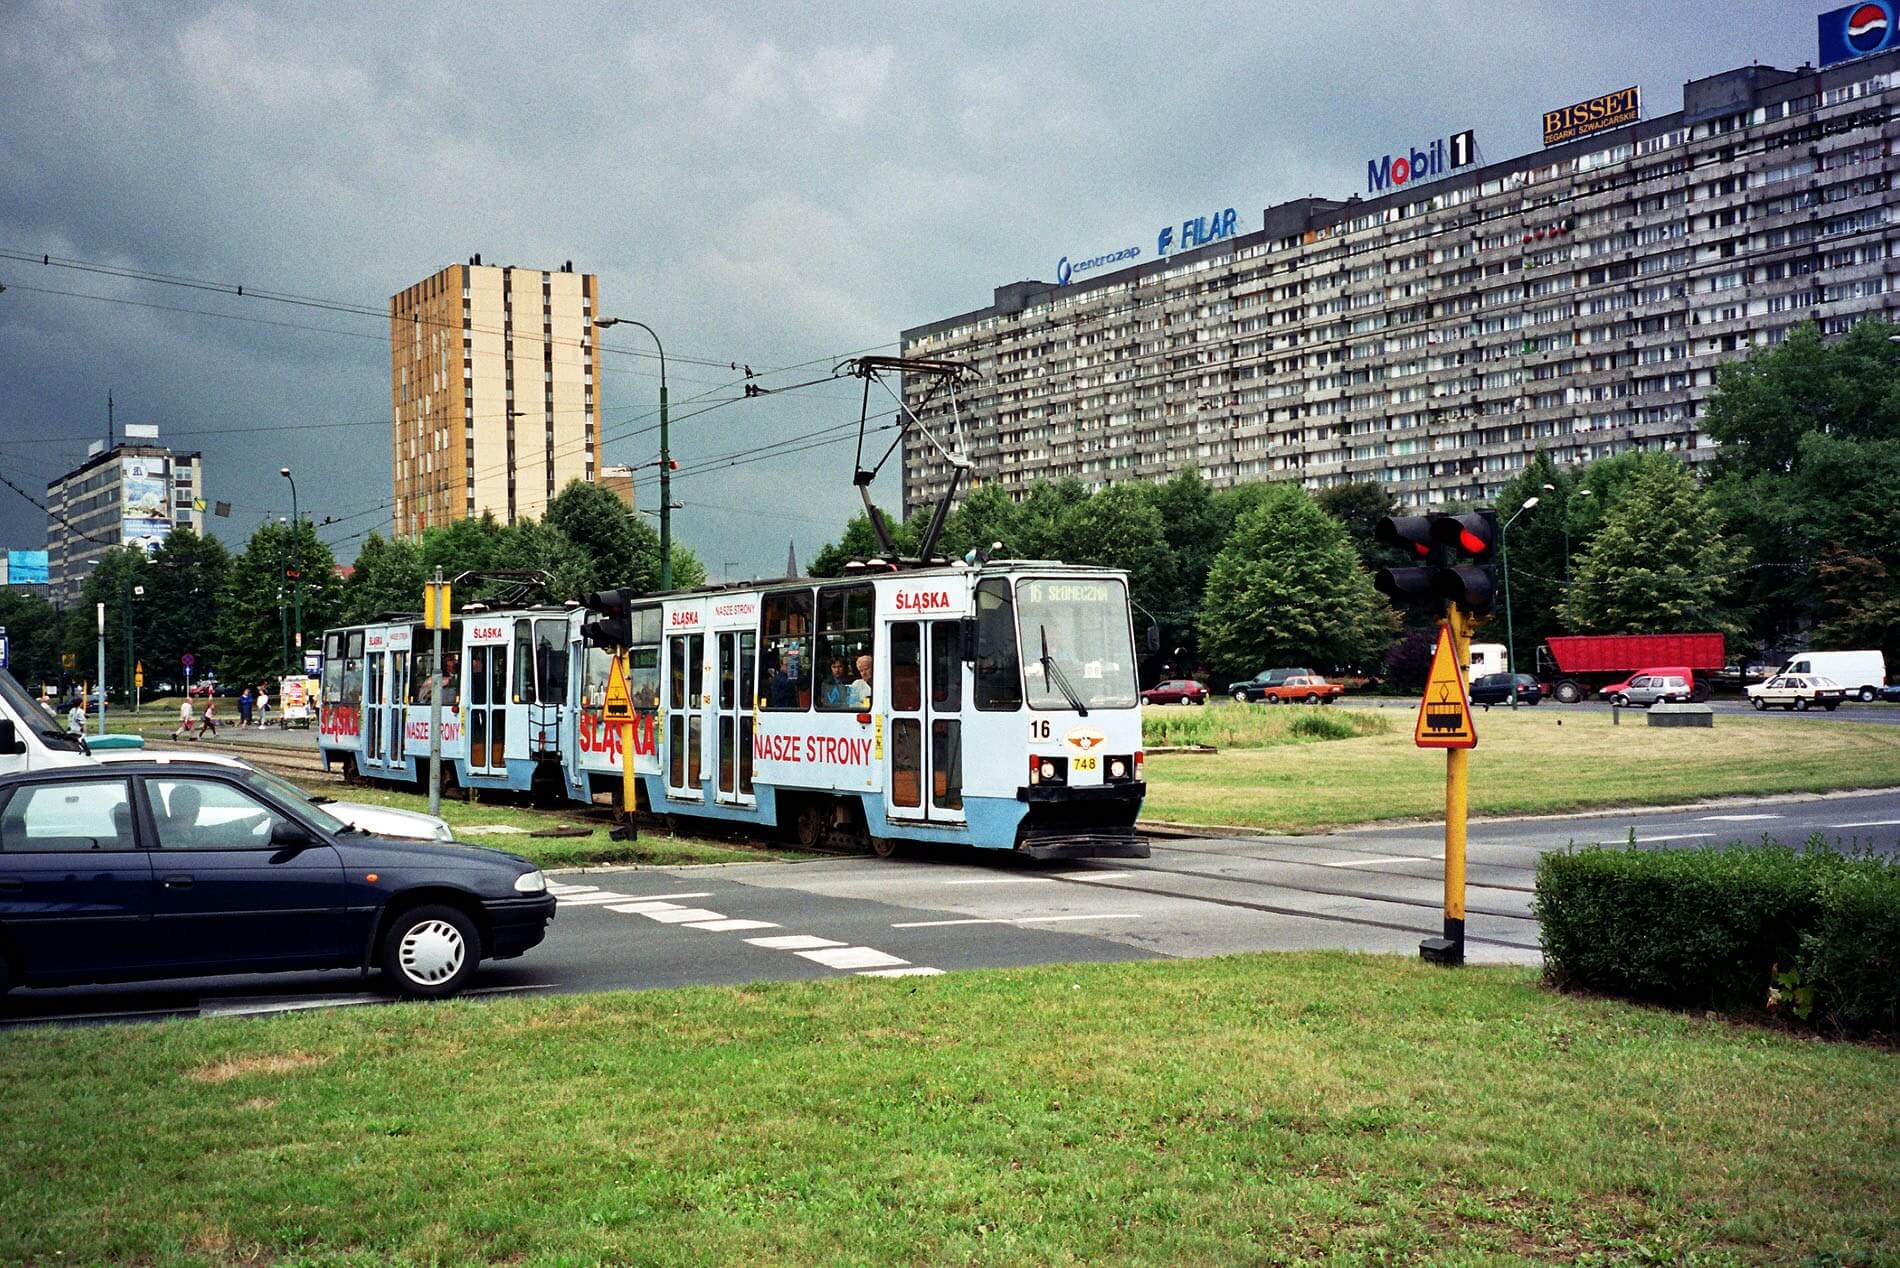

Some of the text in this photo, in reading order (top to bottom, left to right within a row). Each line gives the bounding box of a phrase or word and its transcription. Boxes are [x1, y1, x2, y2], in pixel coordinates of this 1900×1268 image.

[1544, 87, 1638, 134] BISSET
[1545, 111, 1637, 144] ZEGARKI SZWAJCARSKIE
[1368, 133, 1467, 193] Mobil 1
[1181, 207, 1236, 248] FILAR
[1072, 247, 1141, 273] centrozap
[716, 603, 755, 617] NASZE STRONY
[896, 590, 950, 613] ŚLĄSKA
[672, 610, 699, 628] ŚLĄSKA
[406, 722, 429, 739] NASZE
[1030, 720, 1050, 738] 16
[754, 735, 801, 762] NASZE
[806, 735, 872, 766] STRONY
[1073, 758, 1096, 770] 748
